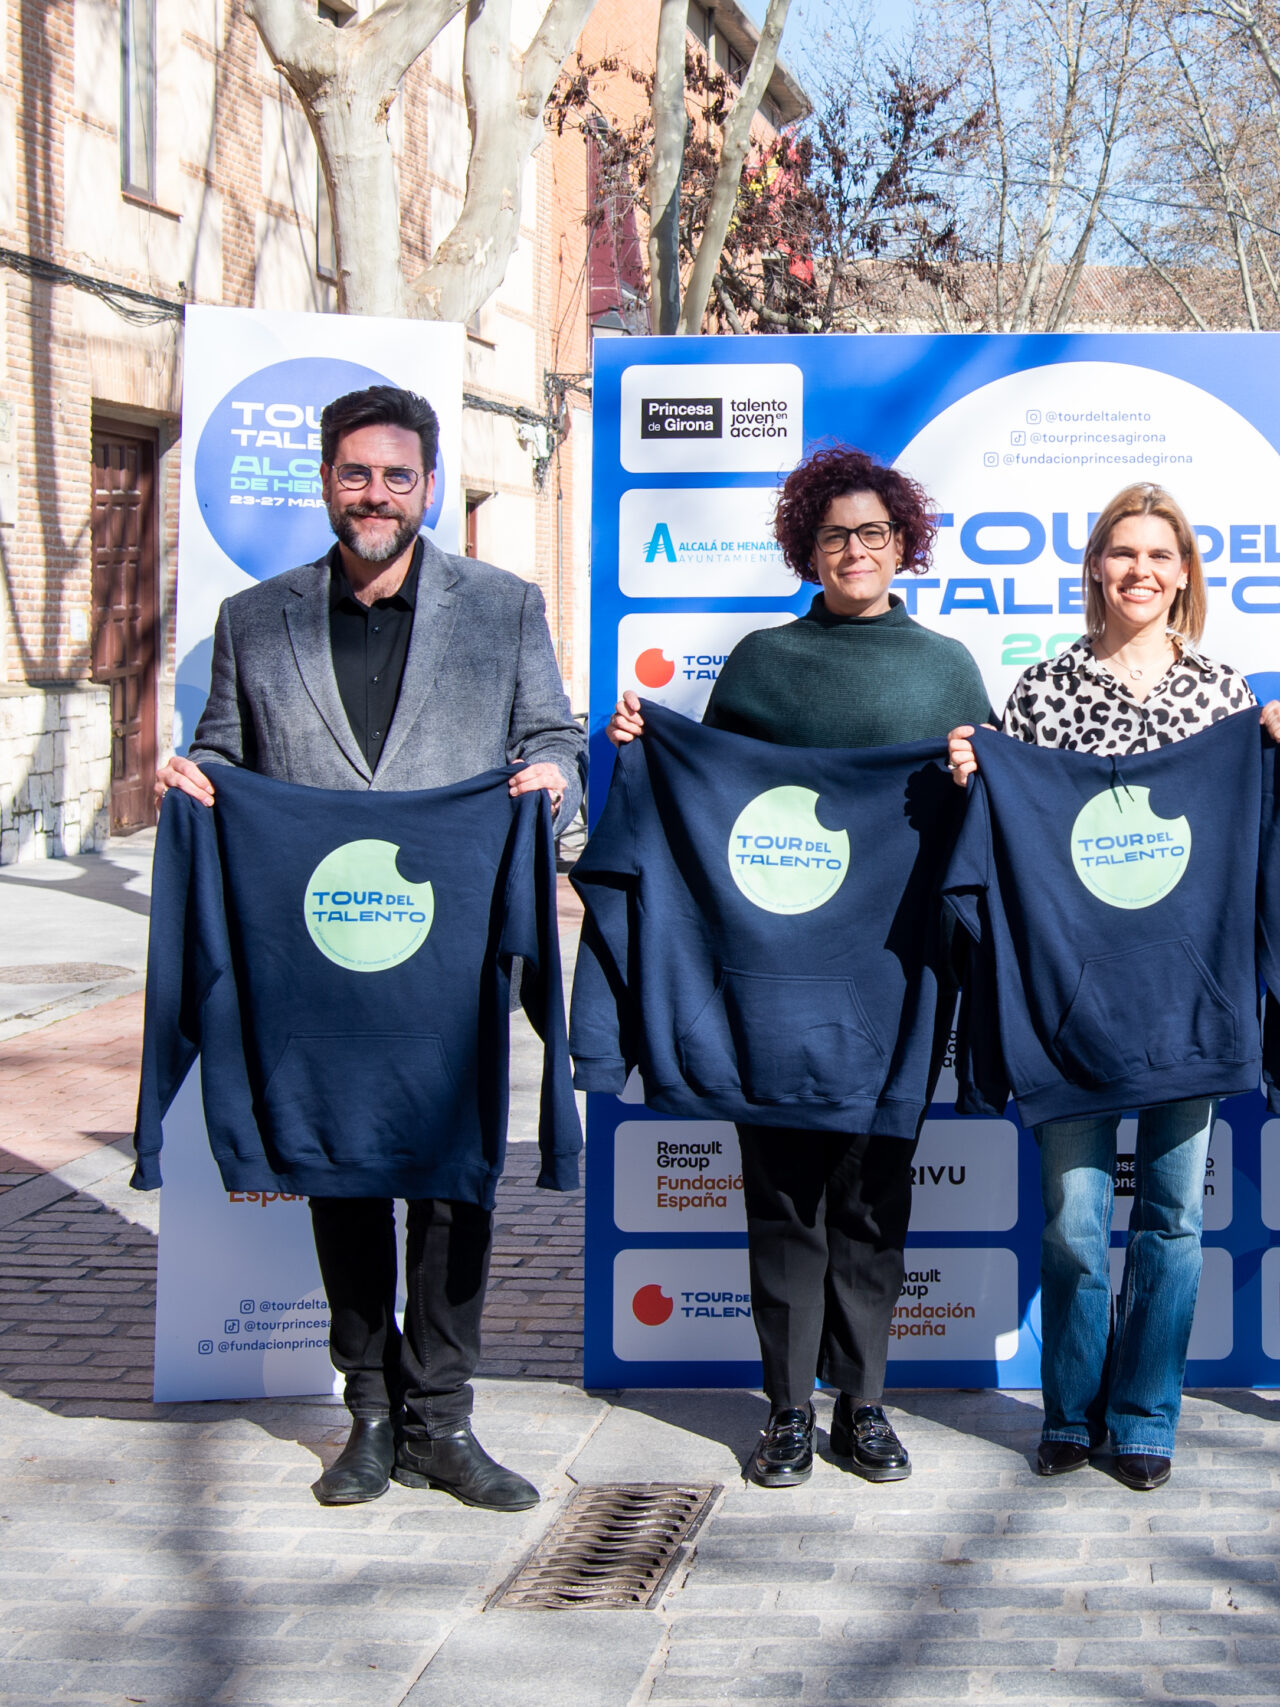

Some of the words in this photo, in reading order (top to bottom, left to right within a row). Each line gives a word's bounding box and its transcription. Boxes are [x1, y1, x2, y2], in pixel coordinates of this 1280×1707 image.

[648, 402, 714, 416] Princesa
[730, 398, 788, 412] talento
[231, 401, 324, 430] TOU
[730, 412, 775, 427] joven
[1045, 410, 1152, 424] @tourdeltalento
[648, 422, 661, 431] de
[664, 418, 714, 431] Girona
[730, 423, 788, 438] acción
[230, 428, 322, 451] TALE
[1030, 431, 1166, 446] @tourprincesagirona
[230, 455, 321, 478] ALC
[1003, 452, 1193, 467] @fundacionprincesadegirona
[230, 477, 269, 492] DE
[229, 494, 286, 507] 23-27
[287, 497, 329, 509] MAR
[679, 539, 717, 551] ALCALÁ
[721, 541, 734, 551] DE
[679, 553, 785, 563] AYUNTAMIENTO
[736, 835, 802, 851] TOUR
[805, 840, 832, 853] DEL
[1077, 833, 1144, 852] TOUR
[1146, 831, 1174, 844] DEL
[735, 854, 842, 870] TALENTO
[1080, 846, 1185, 867] TALENTO
[312, 891, 383, 906] TOUR
[386, 894, 415, 906] DEL
[312, 910, 426, 923] TALENTO
[657, 1141, 723, 1154] Renault
[657, 1155, 710, 1172] Group
[657, 1174, 744, 1191] Fundació
[657, 1192, 727, 1212] España
[681, 1292, 734, 1303] TOUR
[735, 1294, 751, 1303] DE
[259, 1299, 331, 1312] @tourdelta
[681, 1307, 752, 1318] TALEN
[887, 1320, 946, 1340] spaña
[218, 1337, 331, 1353] @fundacionprince
